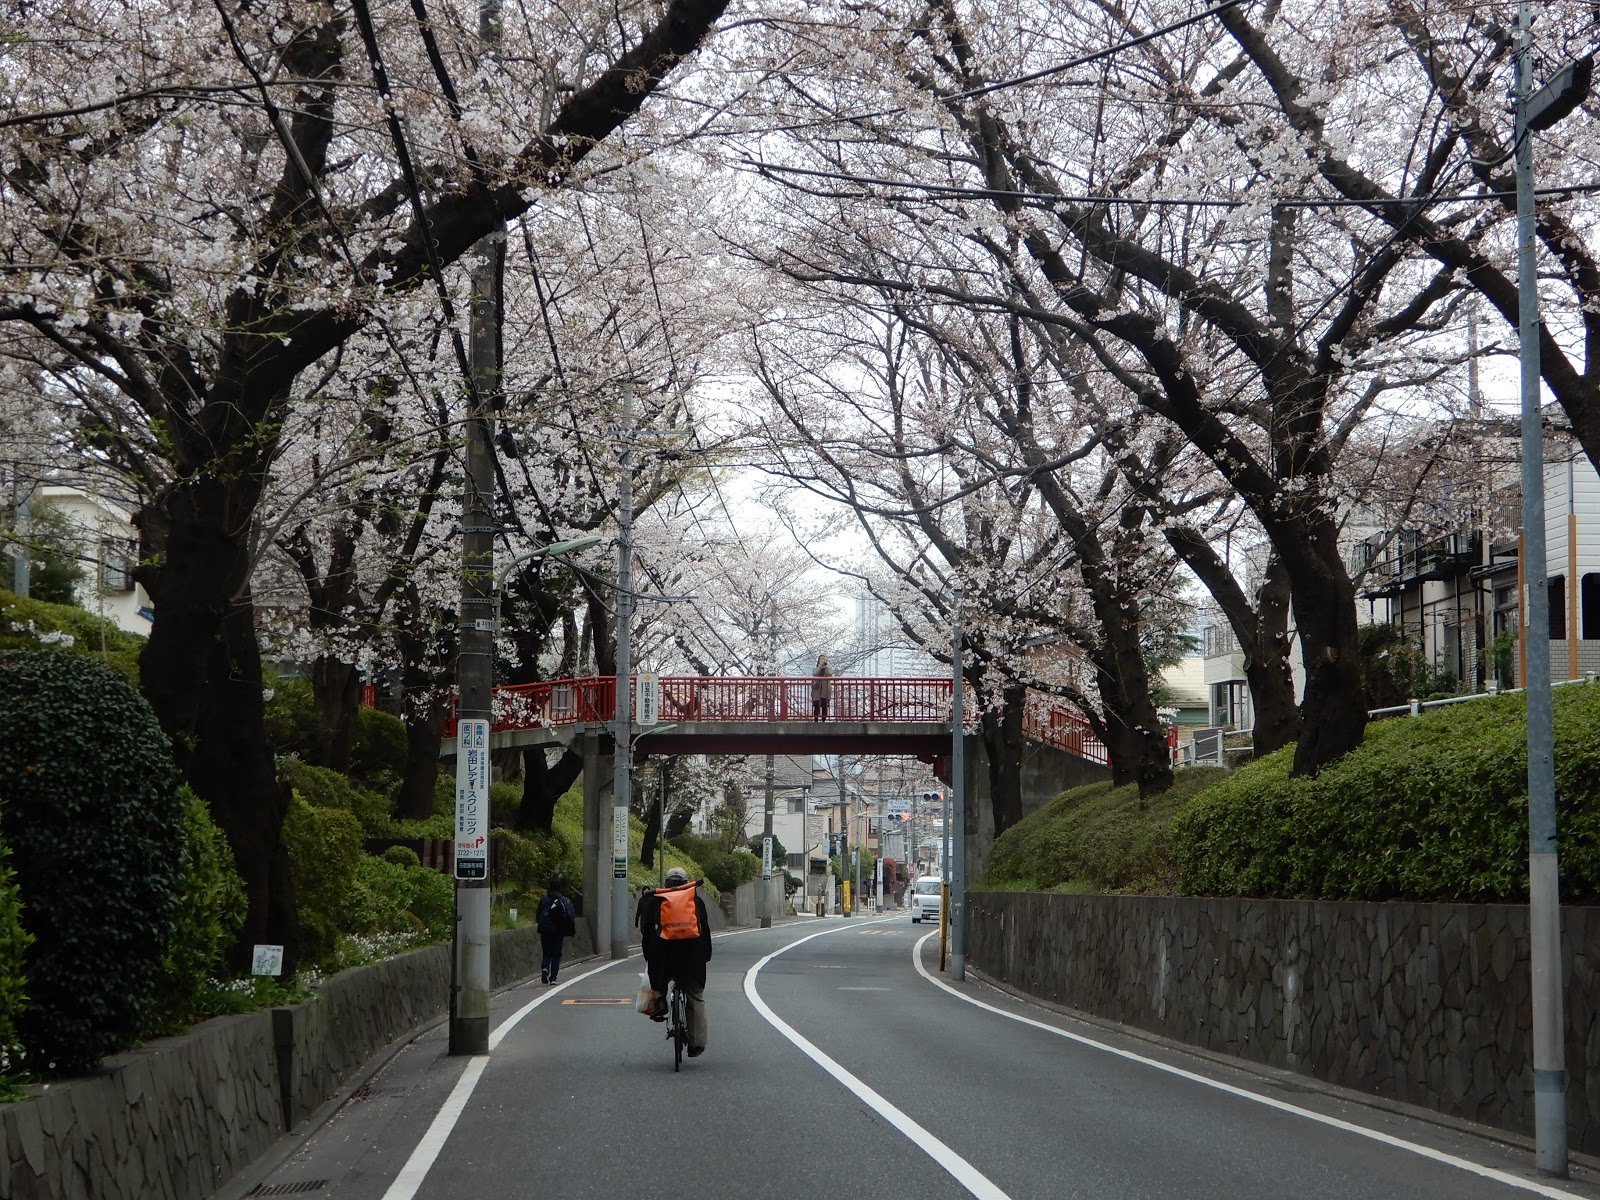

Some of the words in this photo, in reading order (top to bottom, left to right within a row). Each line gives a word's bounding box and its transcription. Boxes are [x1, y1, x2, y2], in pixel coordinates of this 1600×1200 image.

[467, 750, 478, 835] 岩田レディースクリニック
